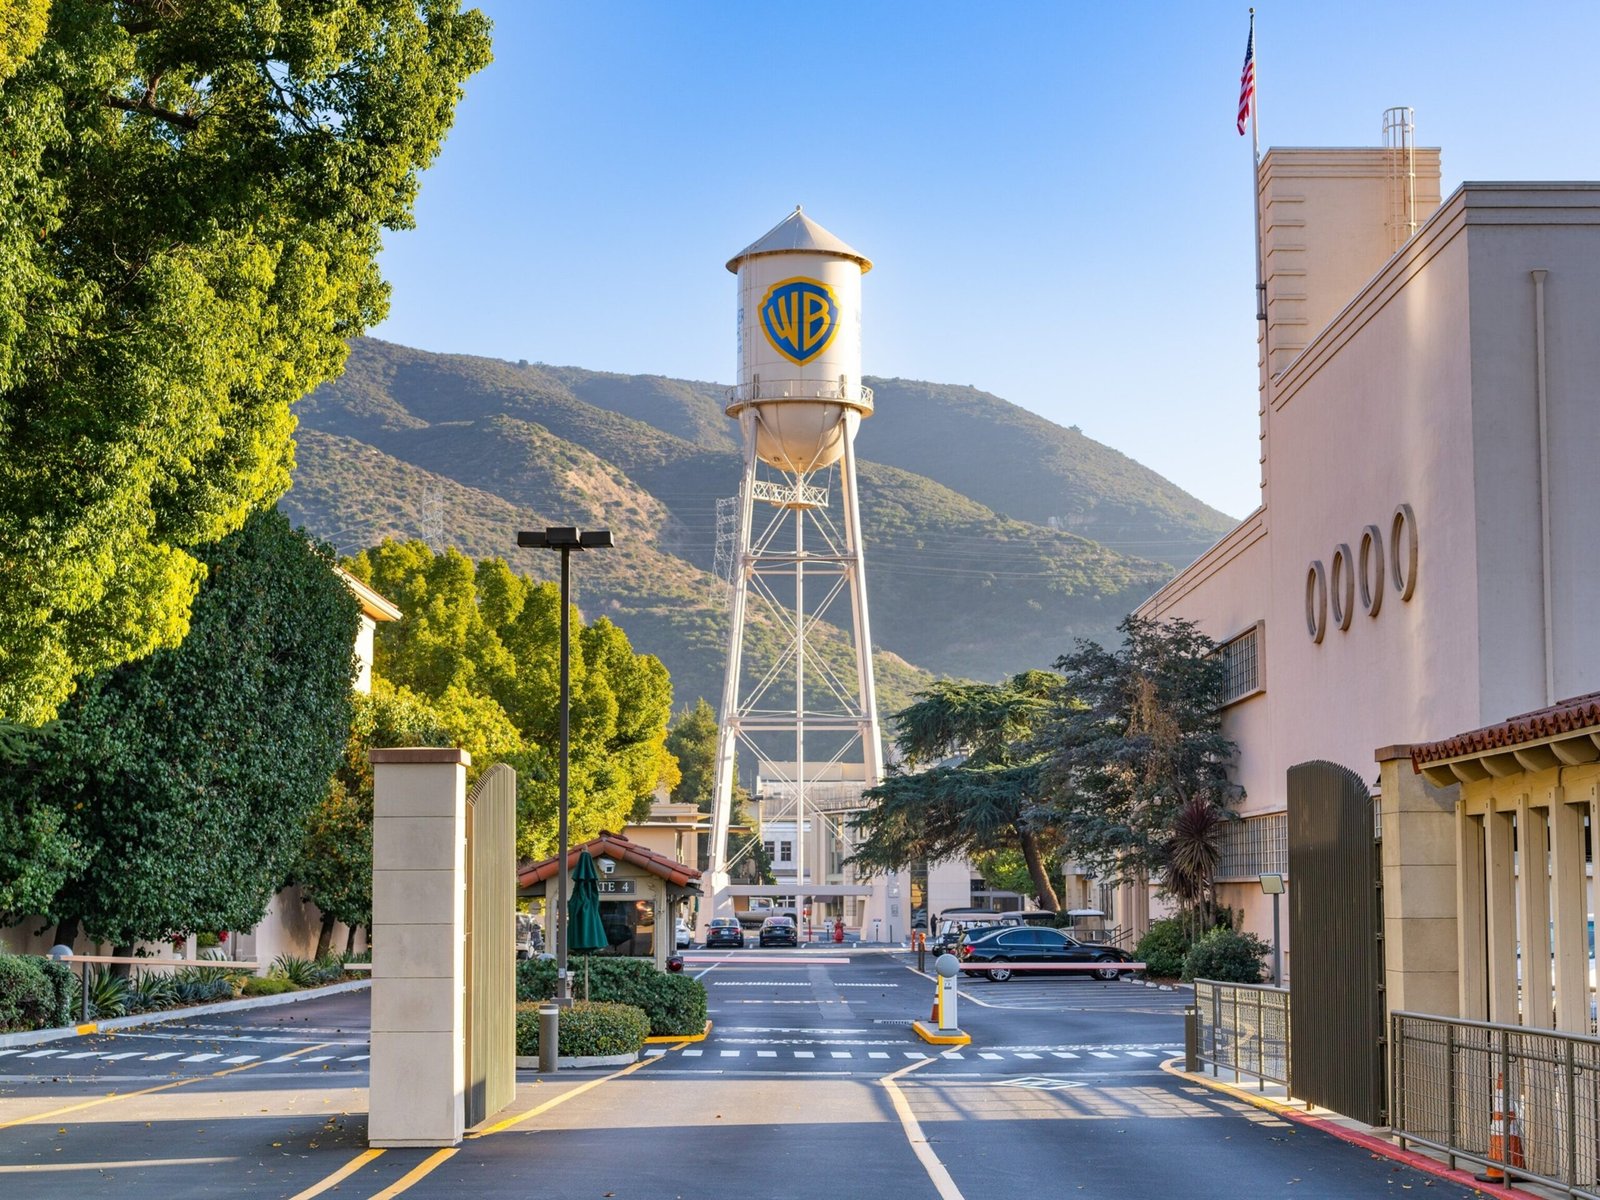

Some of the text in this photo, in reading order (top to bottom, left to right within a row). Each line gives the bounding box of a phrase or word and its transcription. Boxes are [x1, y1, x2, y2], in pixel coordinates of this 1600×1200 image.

[768, 291, 831, 351] WB
[597, 881, 630, 892] TE 4
